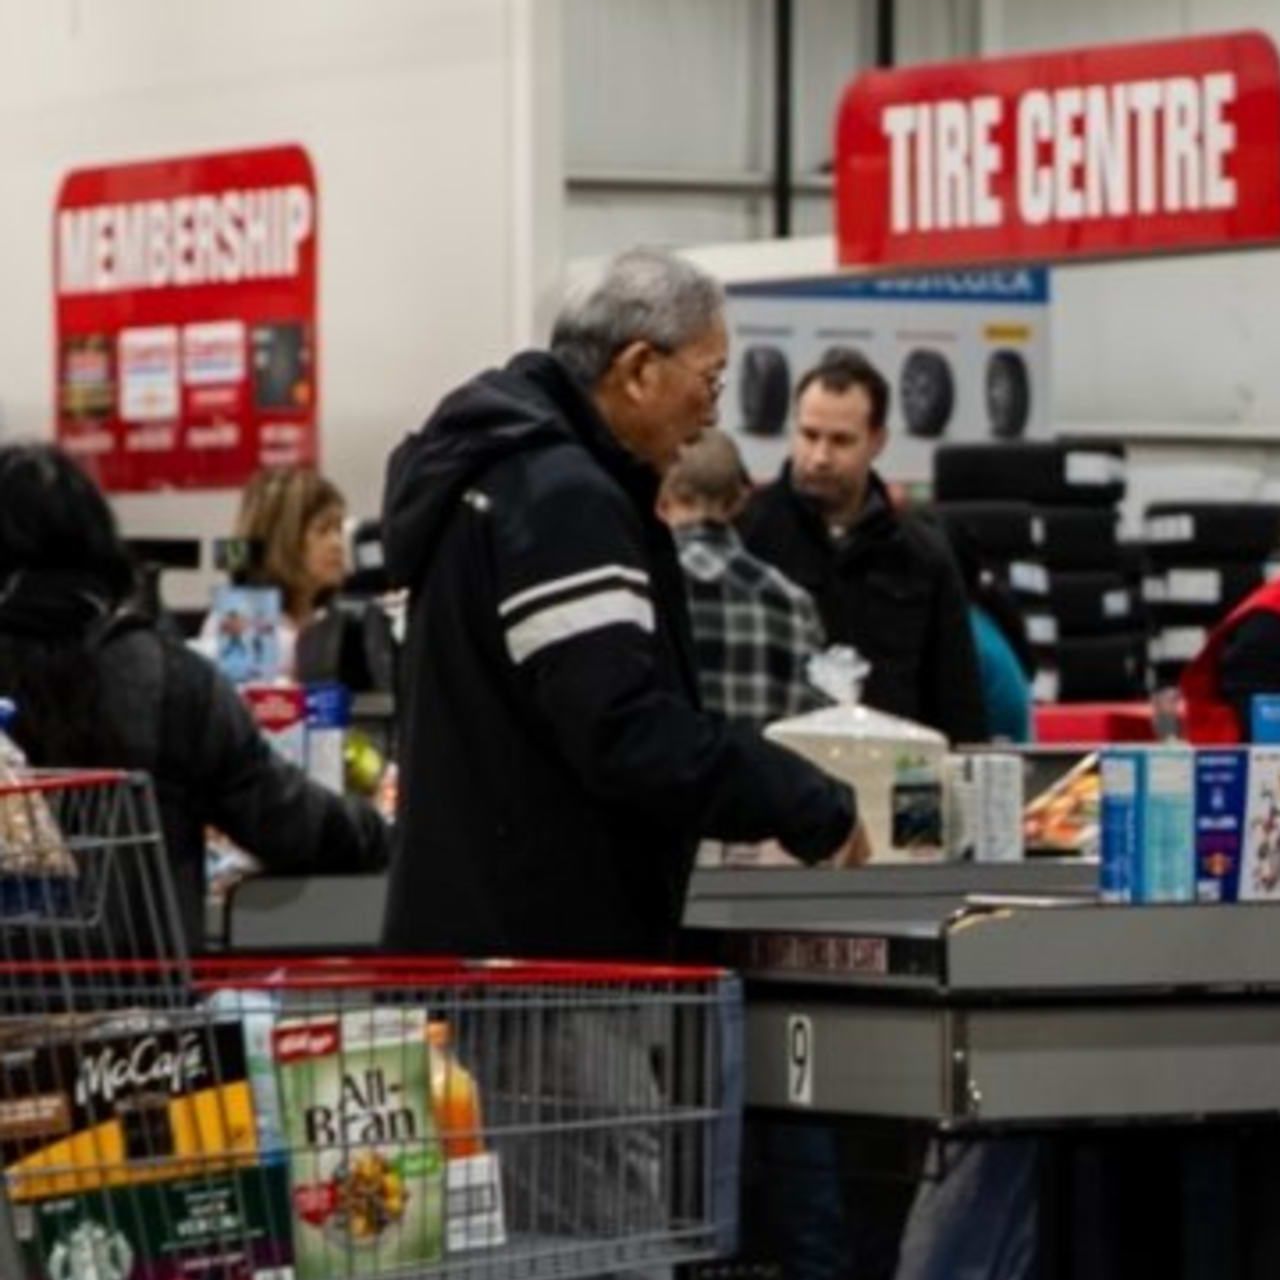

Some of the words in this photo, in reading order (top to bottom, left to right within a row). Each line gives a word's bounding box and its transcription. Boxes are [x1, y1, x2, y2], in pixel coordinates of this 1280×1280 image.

[883, 97, 1002, 233] TIRE
[1017, 73, 1237, 224] CENTRE
[58, 185, 313, 297] MEMBERSHIP
[76, 1032, 205, 1105] McCafé
[339, 1066, 404, 1113] All-
[304, 1105, 418, 1147] Bran
